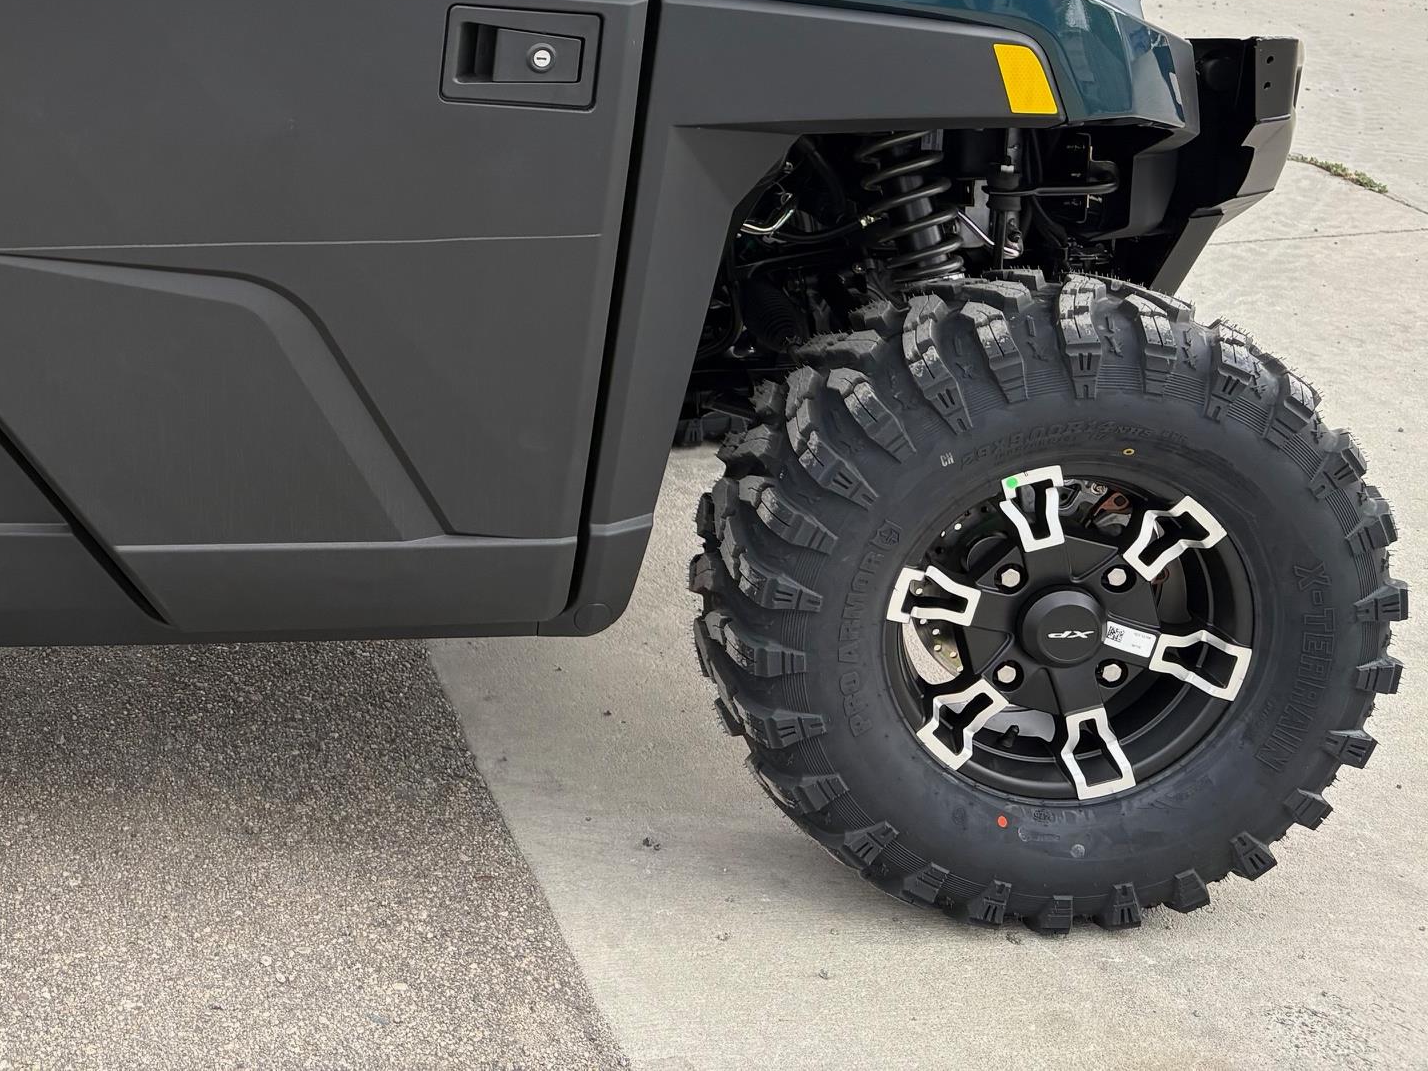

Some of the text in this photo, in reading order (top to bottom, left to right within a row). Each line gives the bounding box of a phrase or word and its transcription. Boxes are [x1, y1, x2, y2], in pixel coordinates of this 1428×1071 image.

[837, 550, 885, 737] PRO ARMOR
[1048, 630, 1095, 639] XP
[1254, 562, 1336, 774] X-TERRAIN
